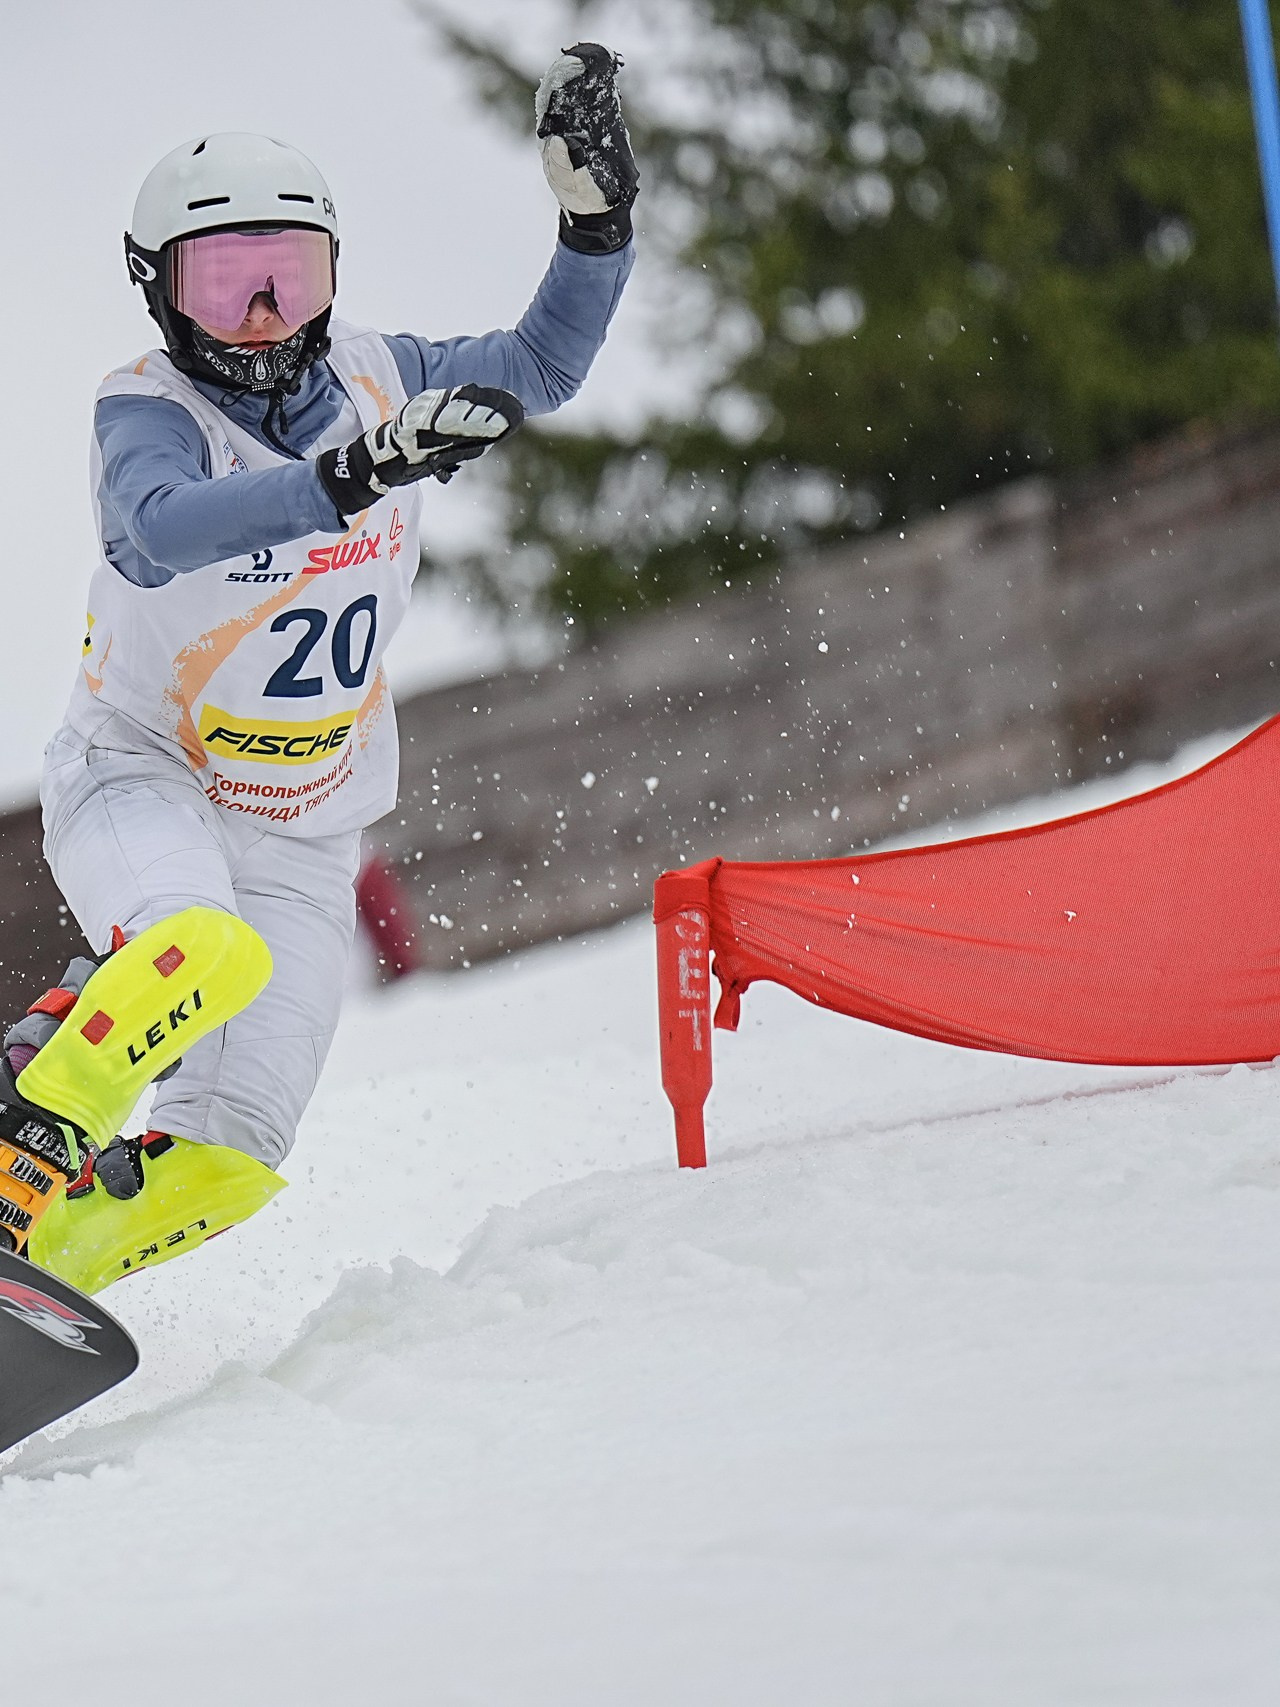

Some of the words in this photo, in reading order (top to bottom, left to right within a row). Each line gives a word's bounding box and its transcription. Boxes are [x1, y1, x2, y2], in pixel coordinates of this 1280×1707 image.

[224, 572, 293, 583] SCOTT
[261, 593, 379, 699] 20
[204, 724, 353, 758] FISCHE
[127, 988, 203, 1066] LEKI
[122, 1218, 207, 1270] LEKI
